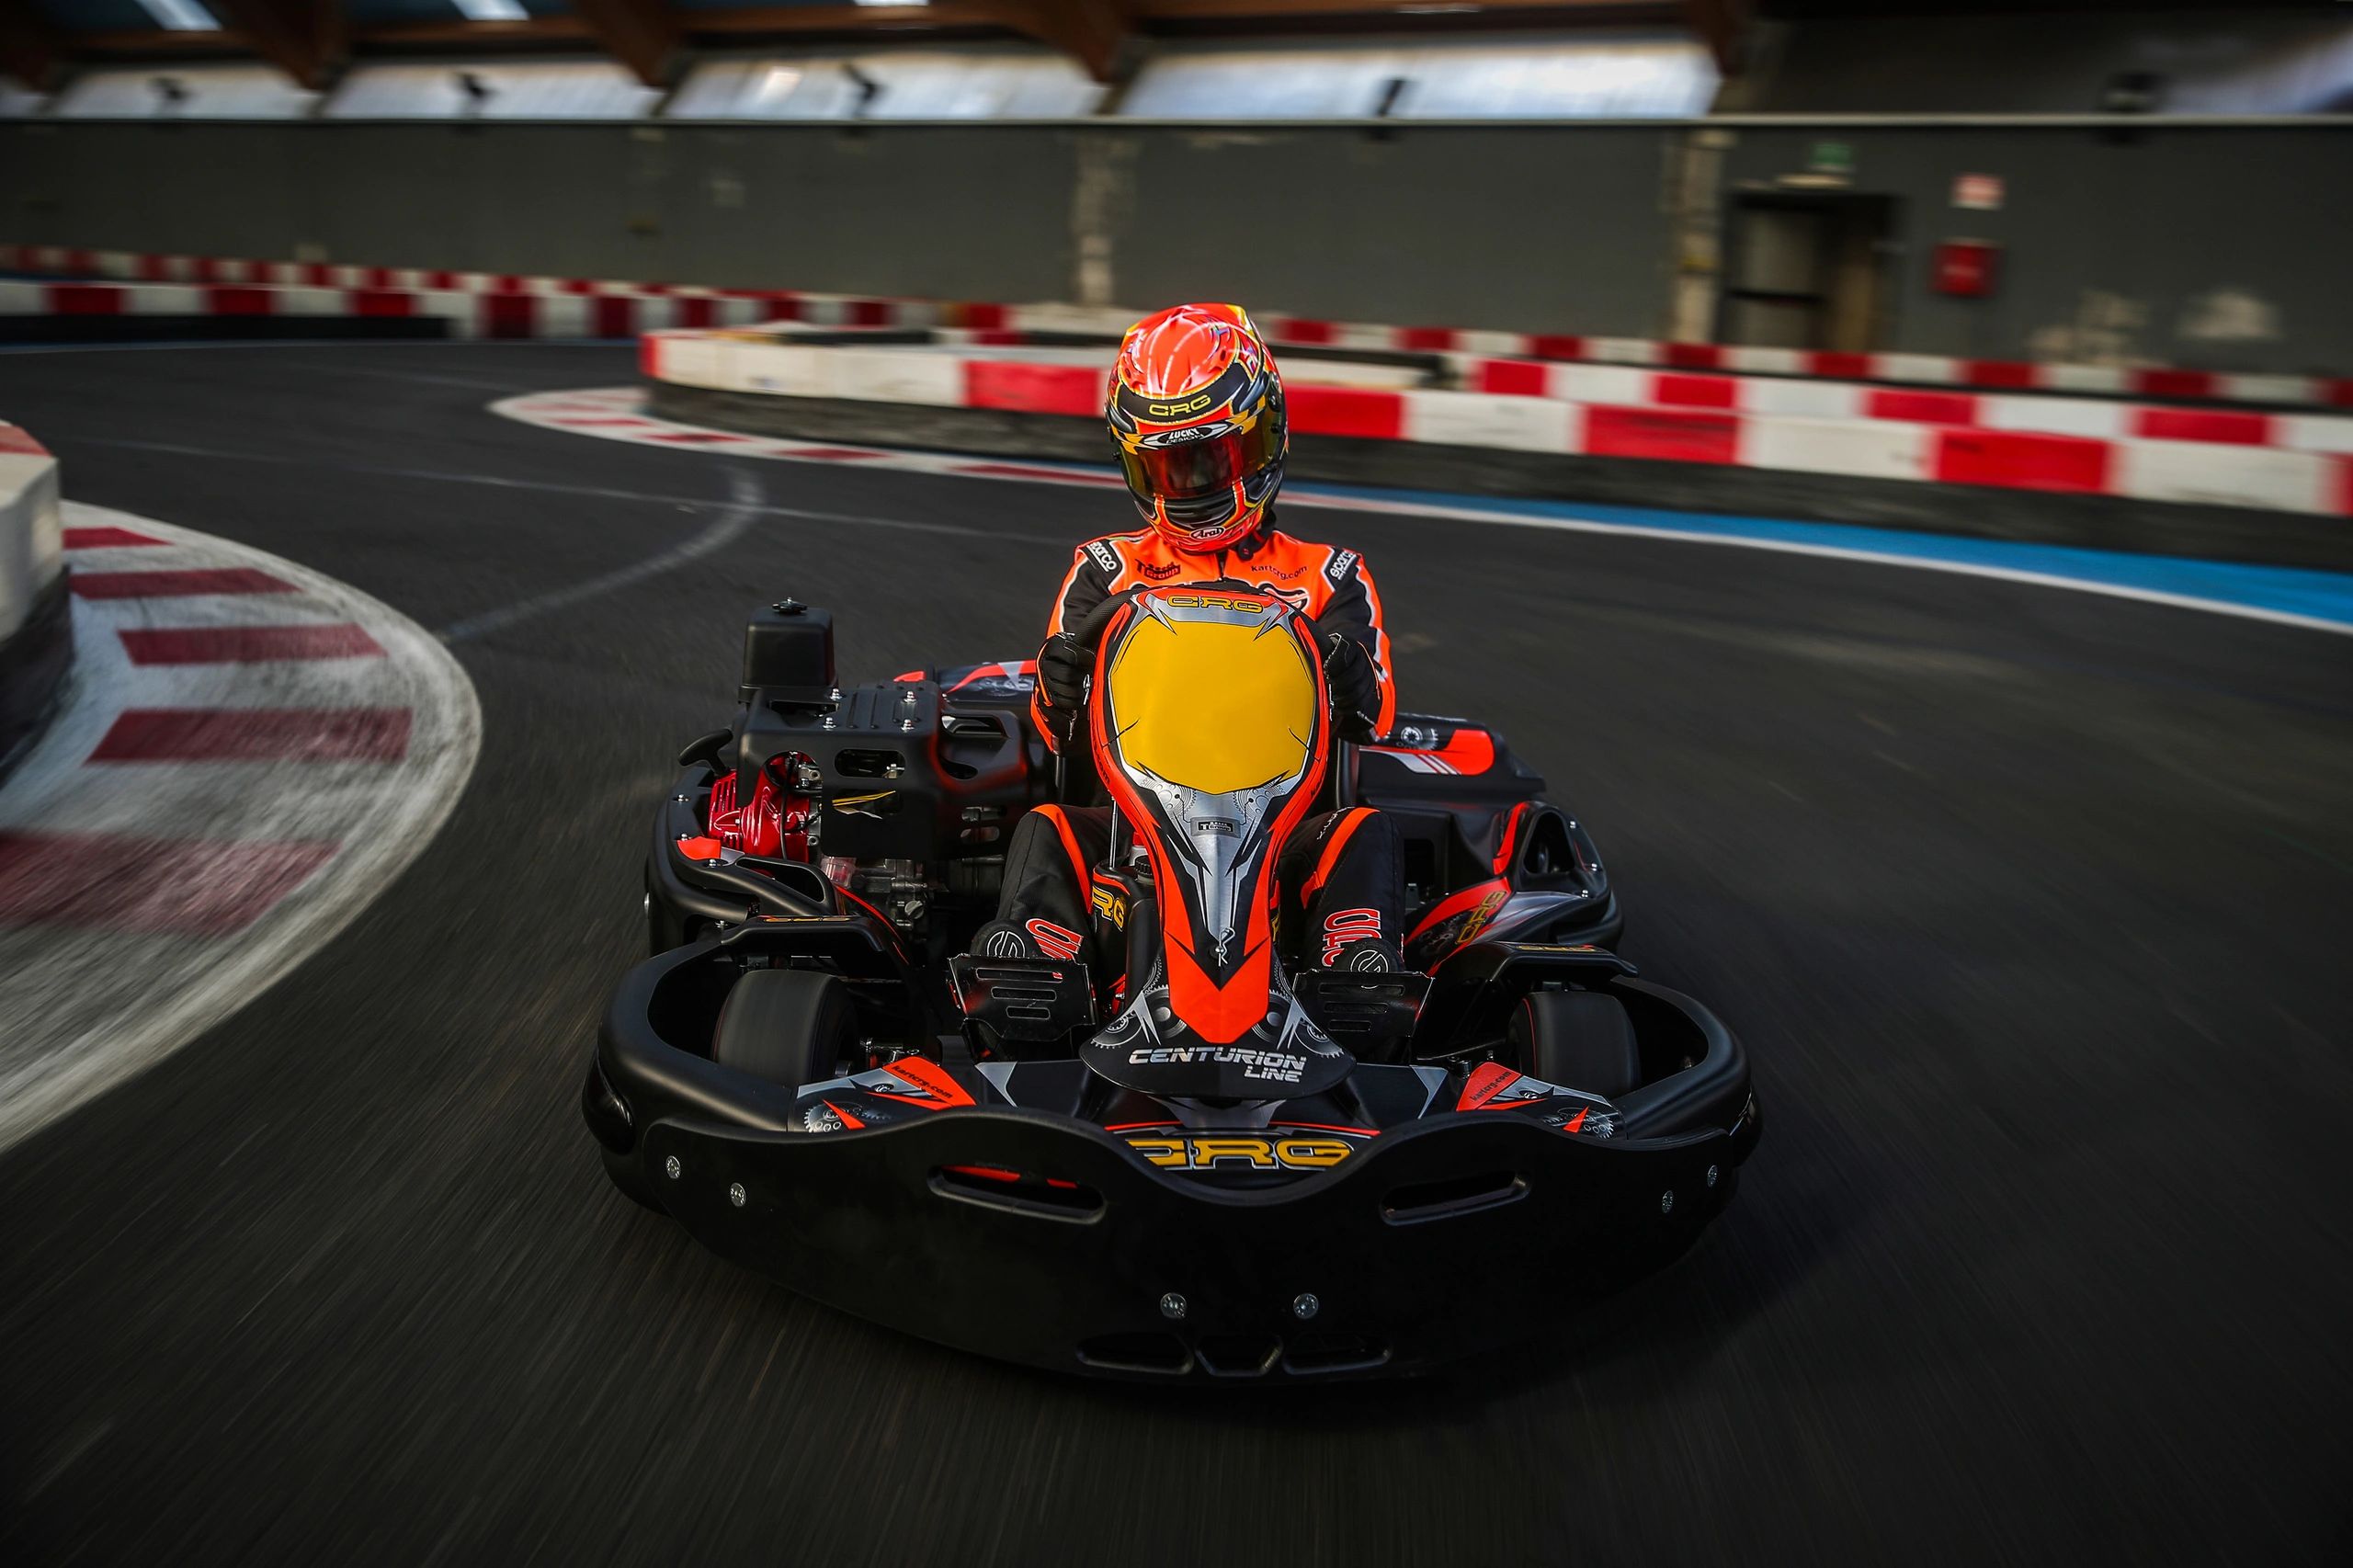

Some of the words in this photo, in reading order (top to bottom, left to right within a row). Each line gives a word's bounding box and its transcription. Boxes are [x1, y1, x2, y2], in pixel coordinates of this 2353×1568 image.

[1149, 394, 1211, 416] CRG
[1168, 427, 1199, 439] LUCKY
[1193, 528, 1222, 540] Arai
[1167, 596, 1263, 613] CRG
[1092, 885, 1126, 932] RG
[1456, 890, 1506, 944] CRG
[1129, 1046, 1307, 1071] CENTURION
[1244, 1066, 1302, 1083] LINE
